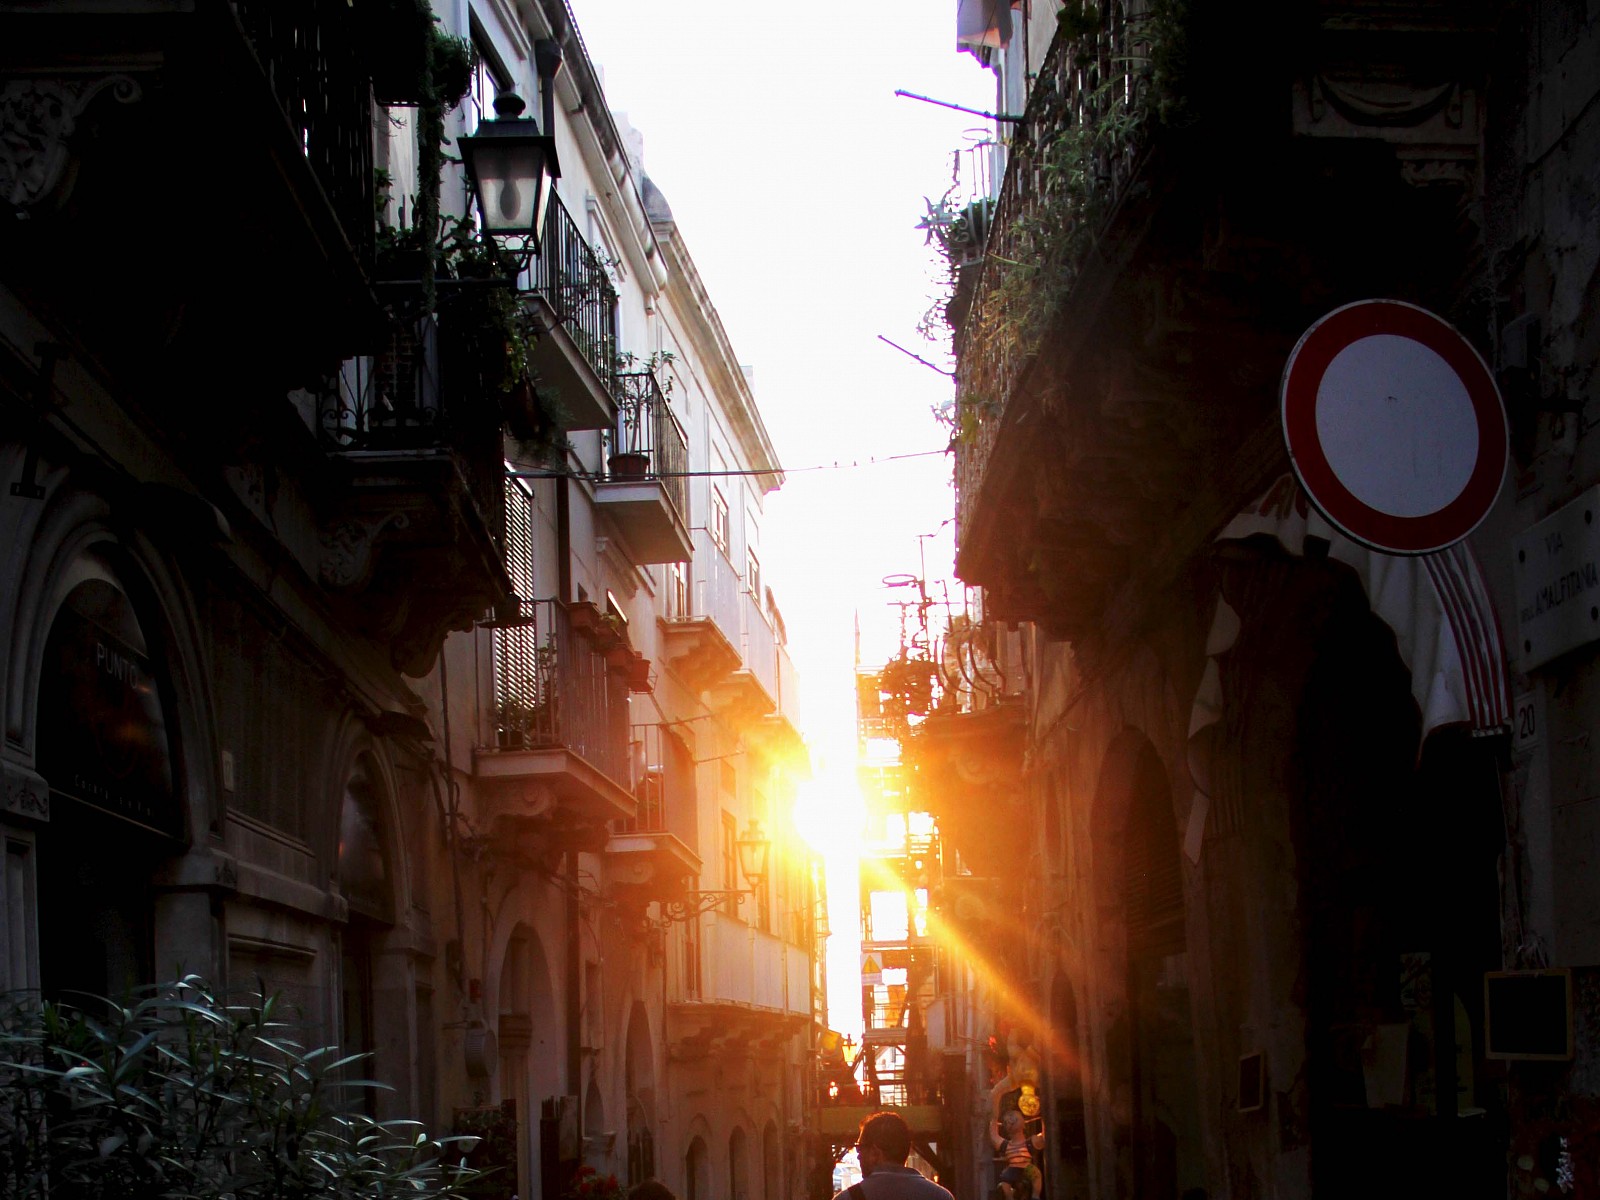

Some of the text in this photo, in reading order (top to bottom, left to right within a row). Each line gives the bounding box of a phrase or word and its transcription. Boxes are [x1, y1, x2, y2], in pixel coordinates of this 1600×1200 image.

[1544, 532, 1563, 554] VIA
[97, 642, 138, 689] PUNTO
[1519, 704, 1535, 739] 20
